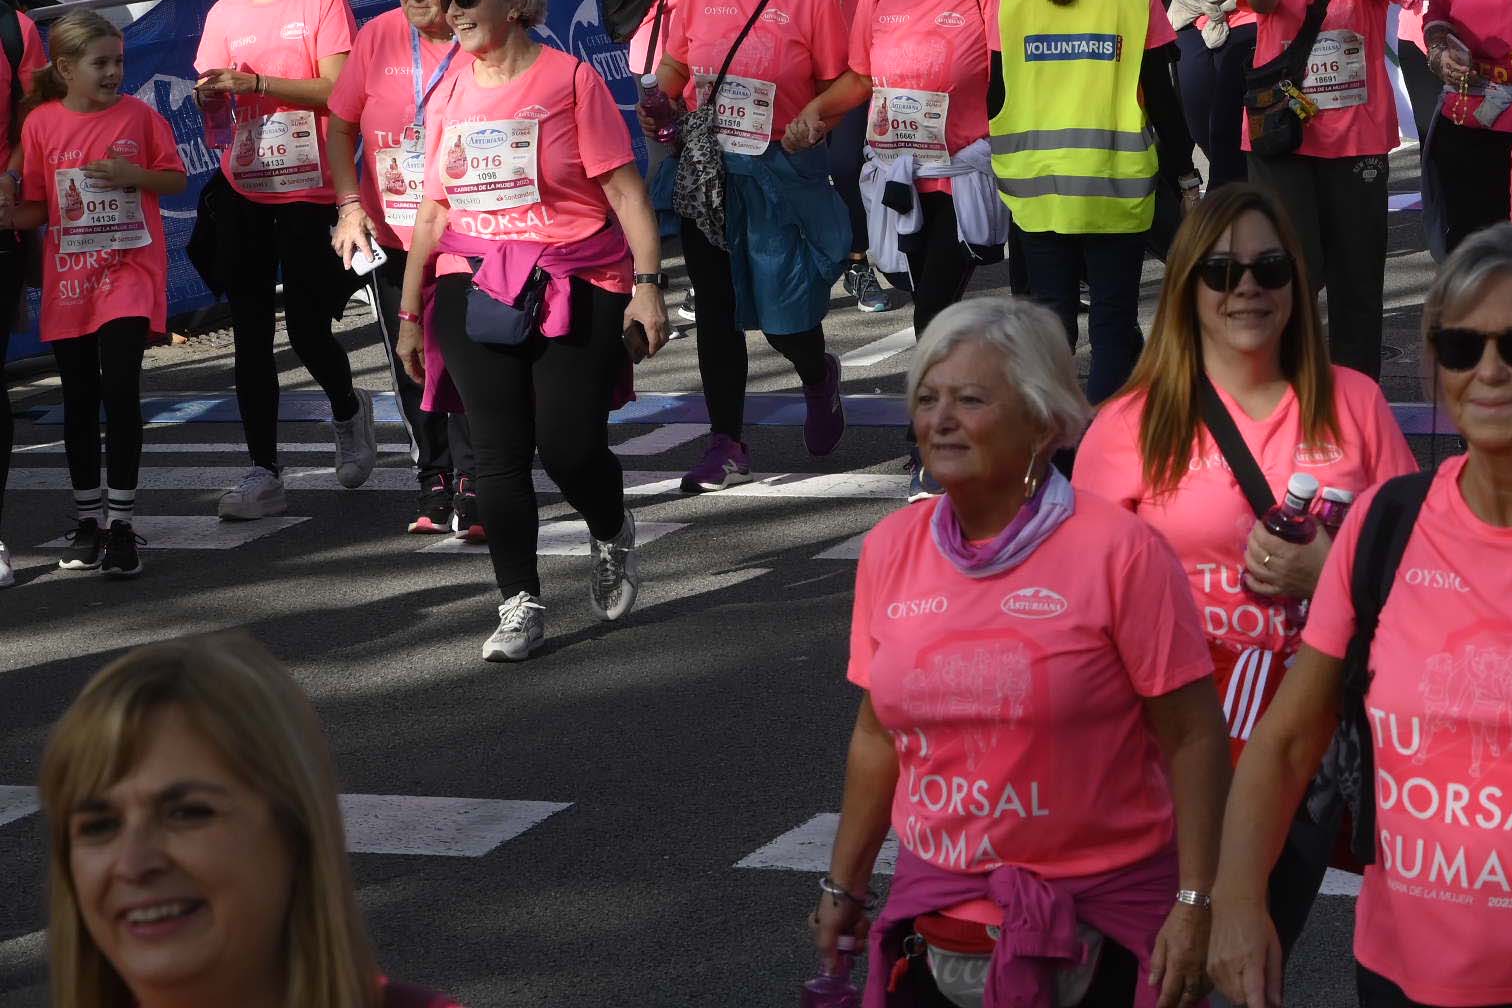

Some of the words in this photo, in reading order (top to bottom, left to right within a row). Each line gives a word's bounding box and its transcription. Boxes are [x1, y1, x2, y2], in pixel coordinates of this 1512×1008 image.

[1026, 40, 1114, 55] VOLUNTARIS
[1311, 60, 1340, 74] 016
[718, 103, 746, 118] 016
[891, 119, 919, 131] 016
[257, 144, 287, 158] 016
[471, 154, 503, 169] 016
[86, 199, 119, 213] 016
[1196, 563, 1242, 594] TU
[887, 596, 948, 620] OYSHO
[1204, 604, 1296, 638] DOR
[1370, 707, 1421, 757] TU
[902, 815, 1001, 870] SUMA
[1379, 829, 1512, 893] SUMA
